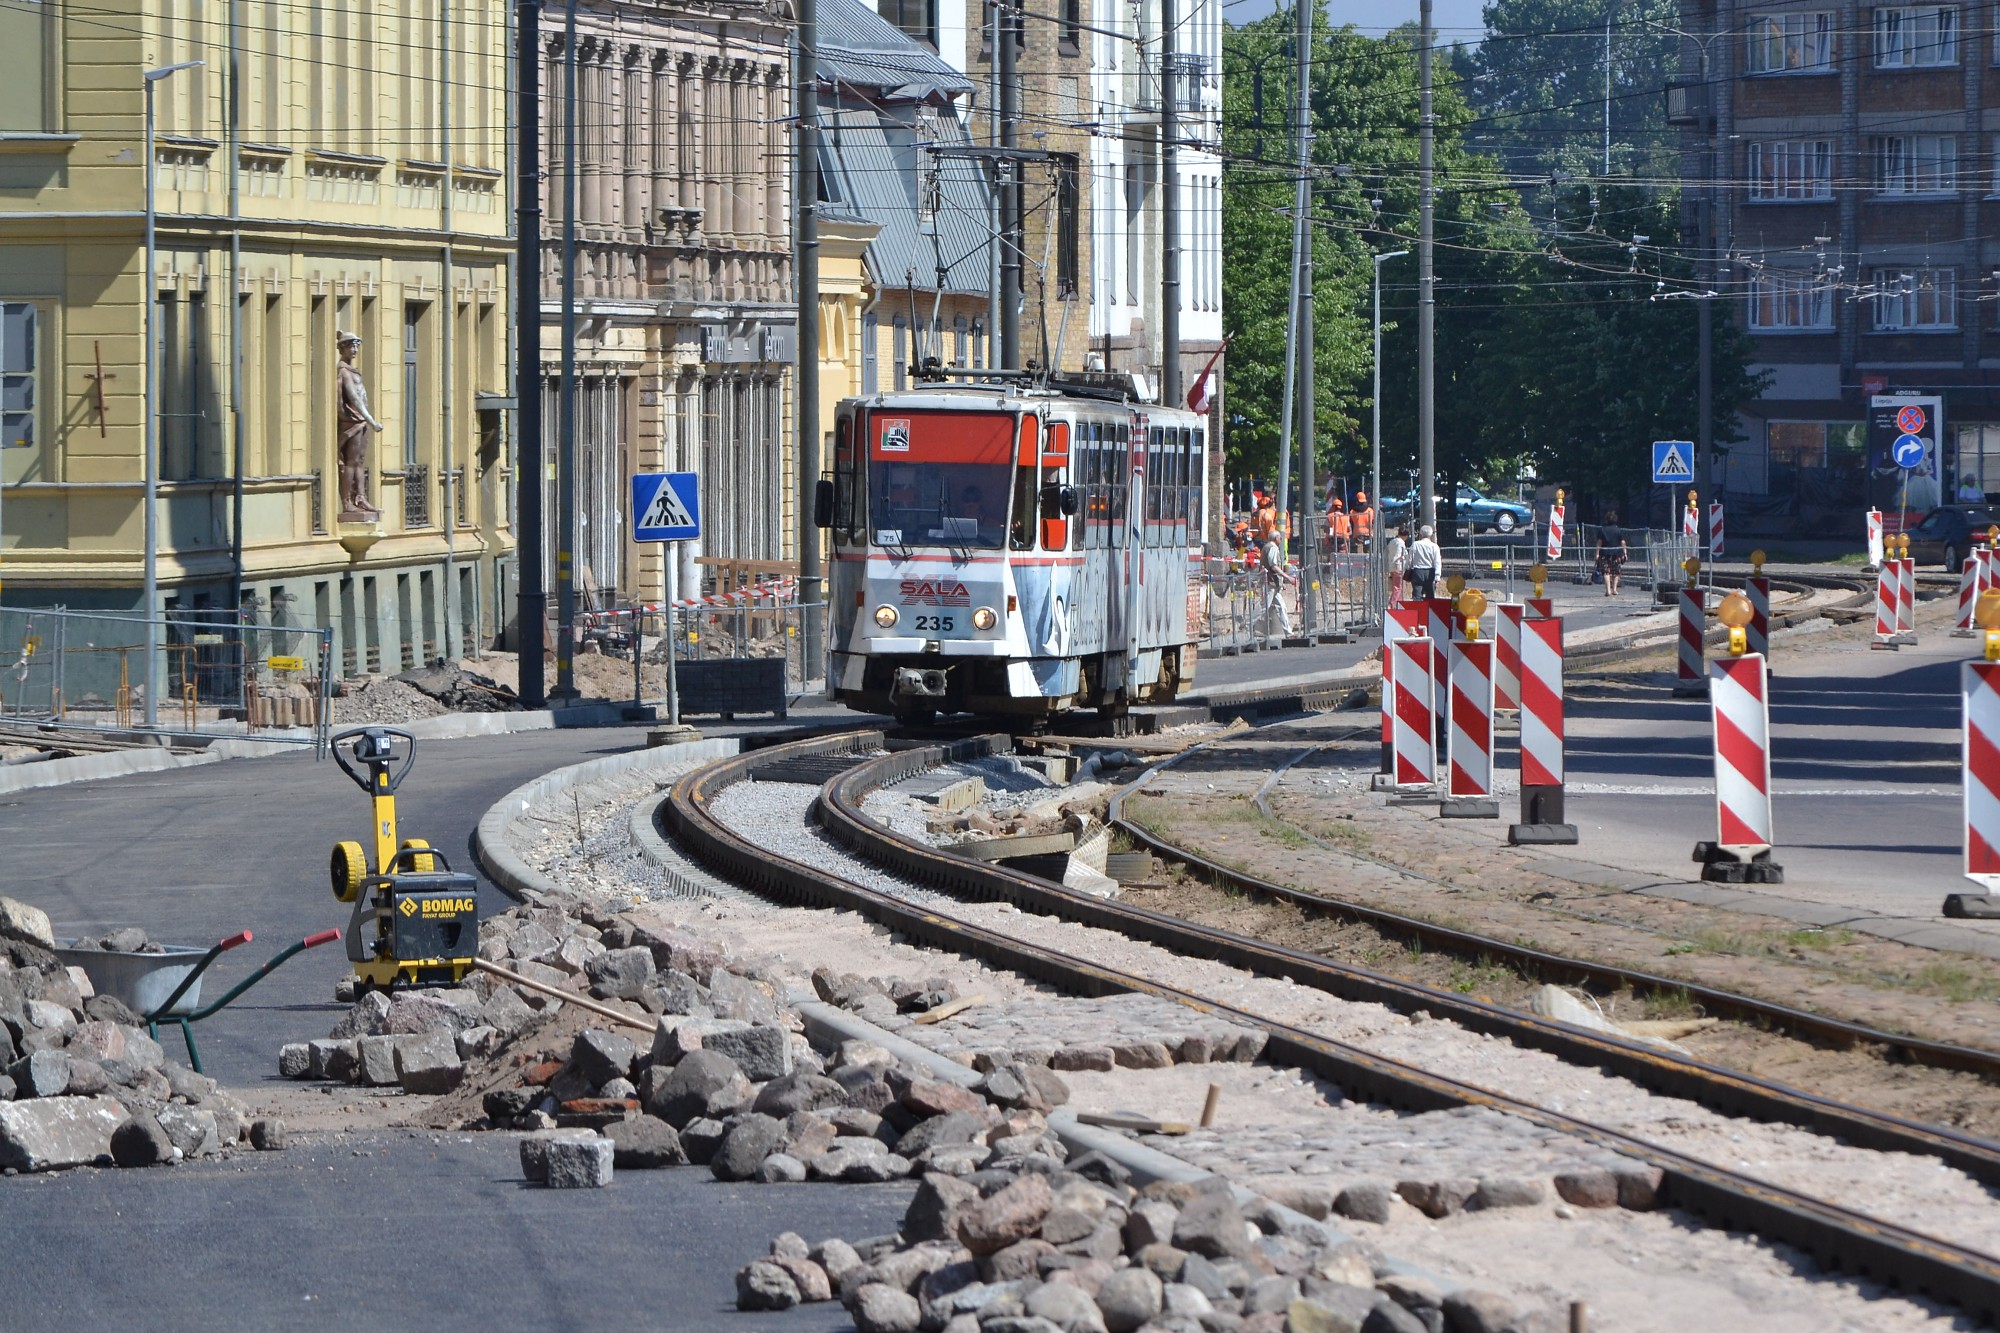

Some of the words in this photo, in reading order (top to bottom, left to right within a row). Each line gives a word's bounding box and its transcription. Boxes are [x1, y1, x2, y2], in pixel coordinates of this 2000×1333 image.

[884, 535, 894, 543] 75
[899, 581, 970, 597] SALA
[915, 615, 954, 632] 235
[422, 898, 474, 913] BOMAG
